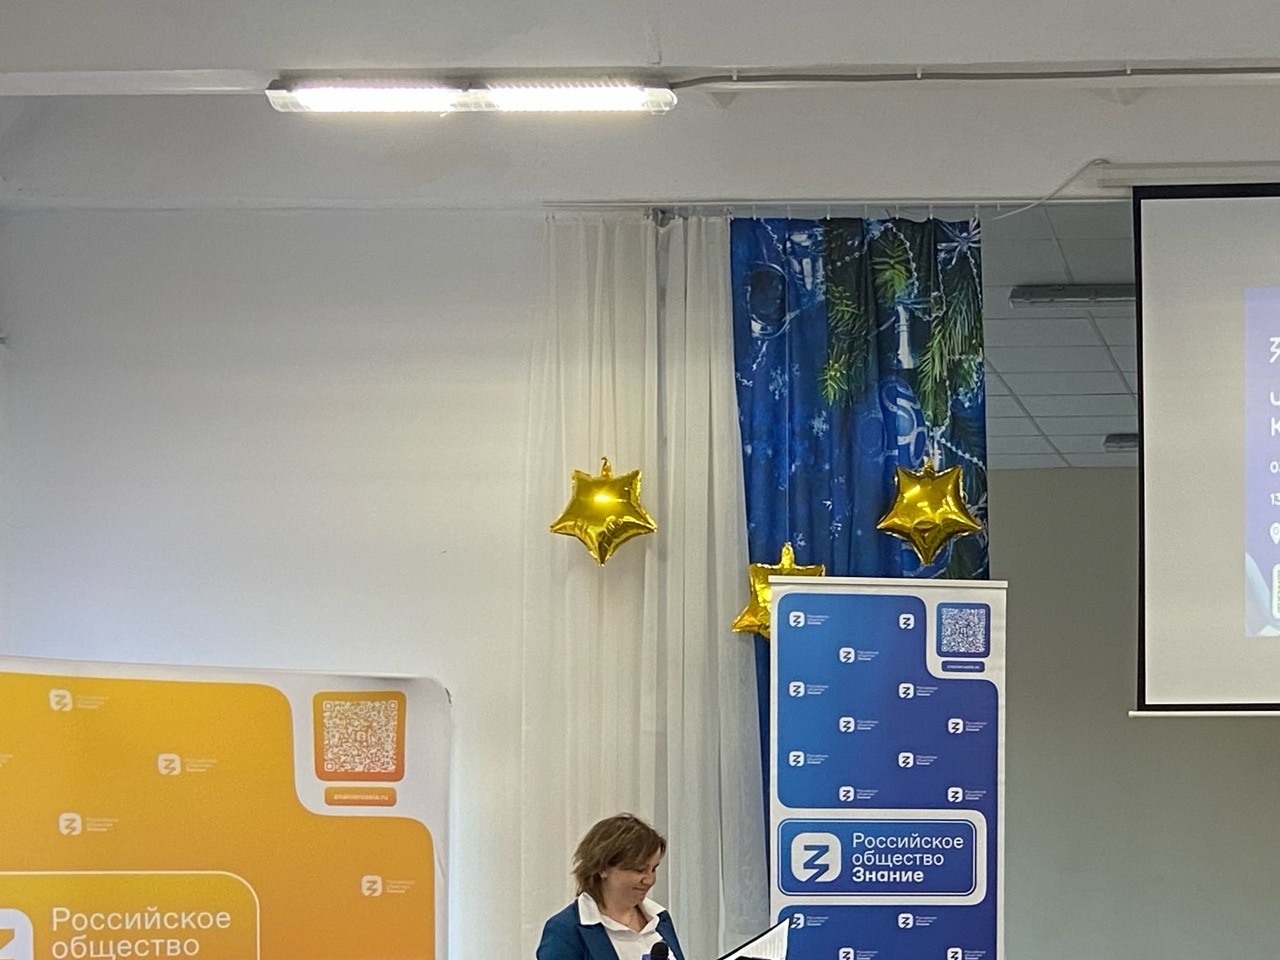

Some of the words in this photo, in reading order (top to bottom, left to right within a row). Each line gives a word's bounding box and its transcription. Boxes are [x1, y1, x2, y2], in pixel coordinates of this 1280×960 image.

[852, 832, 964, 849] Российское
[851, 850, 944, 868] общество
[852, 866, 924, 882] Знание
[52, 905, 232, 932] Российское
